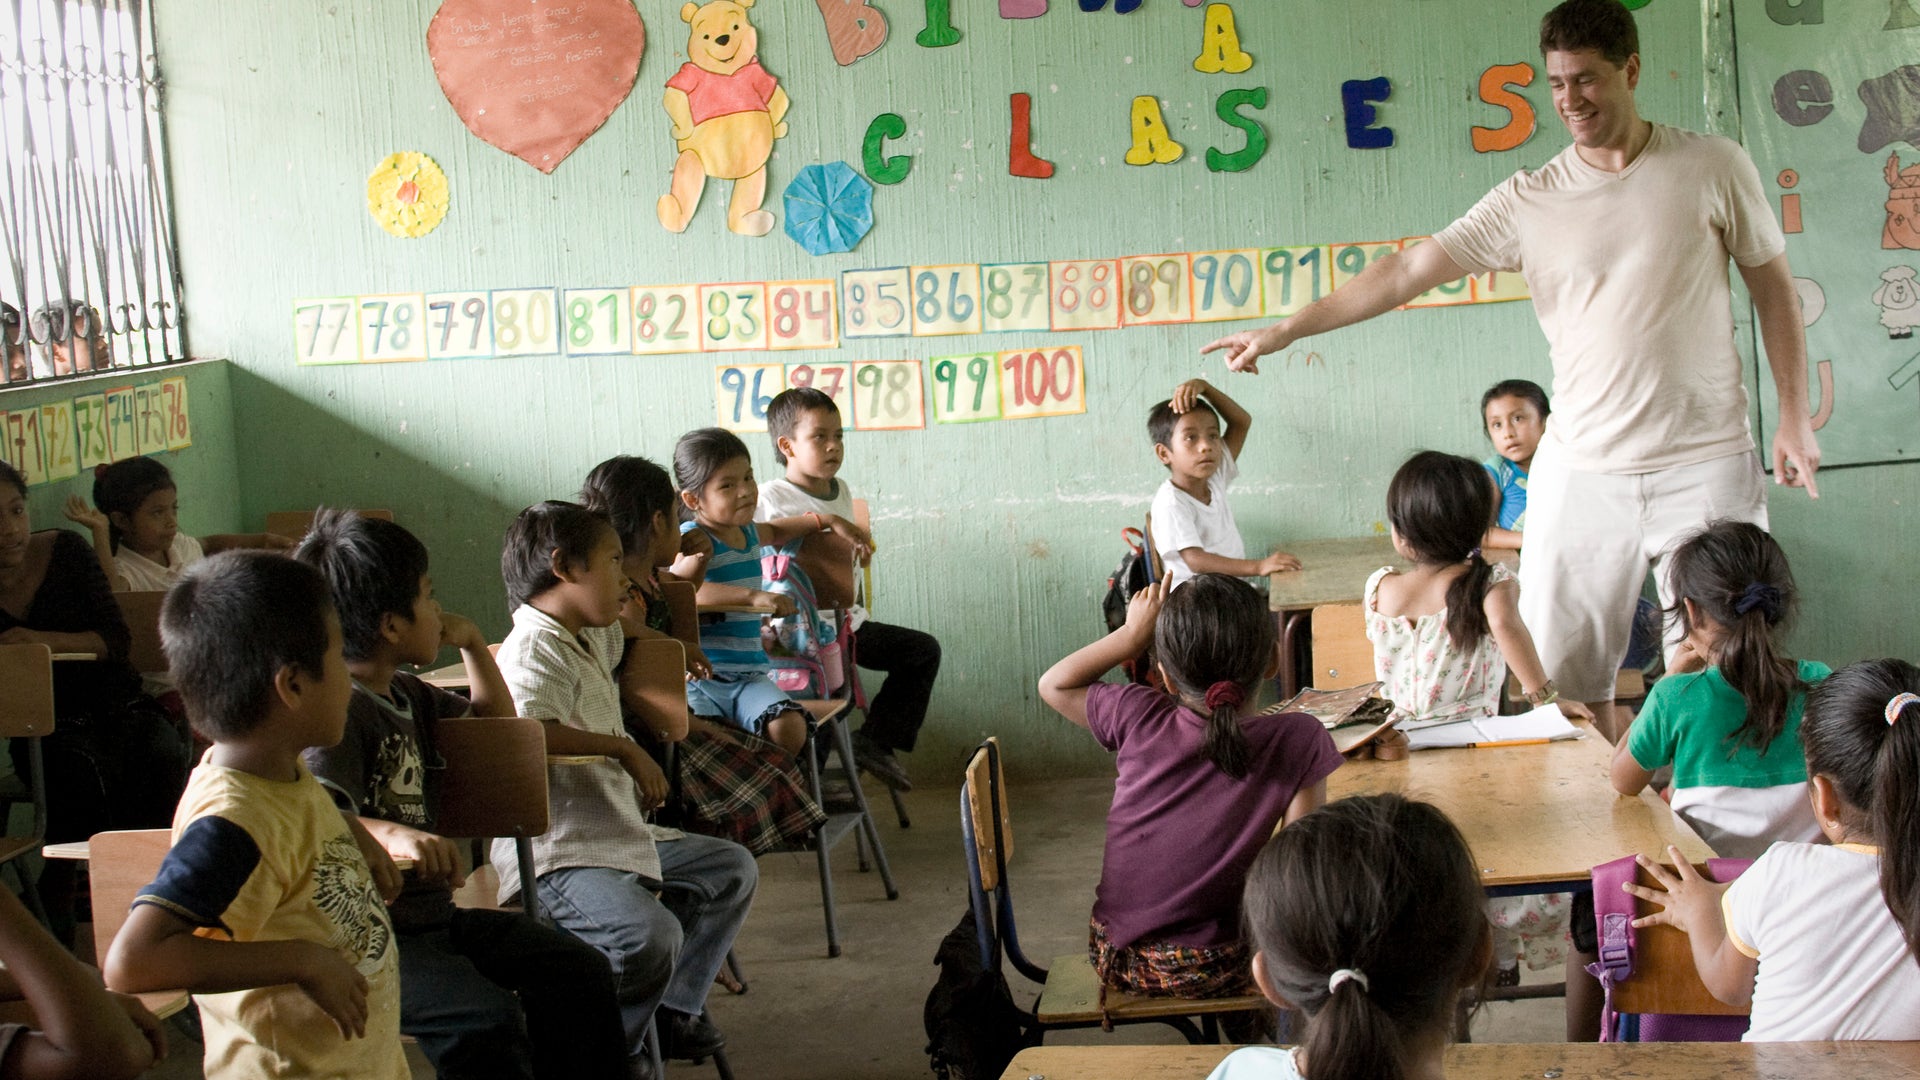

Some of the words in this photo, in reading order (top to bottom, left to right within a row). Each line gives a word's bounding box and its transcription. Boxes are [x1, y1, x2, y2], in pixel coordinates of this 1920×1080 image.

[1193, 3, 1253, 73] A
[1773, 70, 1834, 127] e
[1777, 169, 1804, 233] i
[297, 303, 351, 356] 77
[362, 301, 414, 354] 78
[429, 298, 485, 351] 79
[495, 292, 551, 349] 80
[567, 294, 618, 347] 81
[636, 292, 690, 343] 82
[707, 290, 762, 342] 83
[773, 287, 832, 341] 84
[847, 278, 904, 328] 85
[915, 271, 973, 323] 86
[987, 266, 1045, 319] 87
[1056, 262, 1111, 314] 88
[1128, 259, 1180, 316] 89
[1192, 254, 1253, 310] 90
[1265, 248, 1320, 306] 91
[721, 367, 772, 422] 96
[857, 363, 910, 419] 98
[935, 357, 988, 412] 99
[1003, 349, 1074, 406] 100
[10, 410, 42, 478] 71
[43, 406, 72, 469] 72
[76, 401, 106, 459] 73
[108, 394, 135, 452] 74
[138, 390, 165, 445] 75
[163, 383, 187, 440] 76
